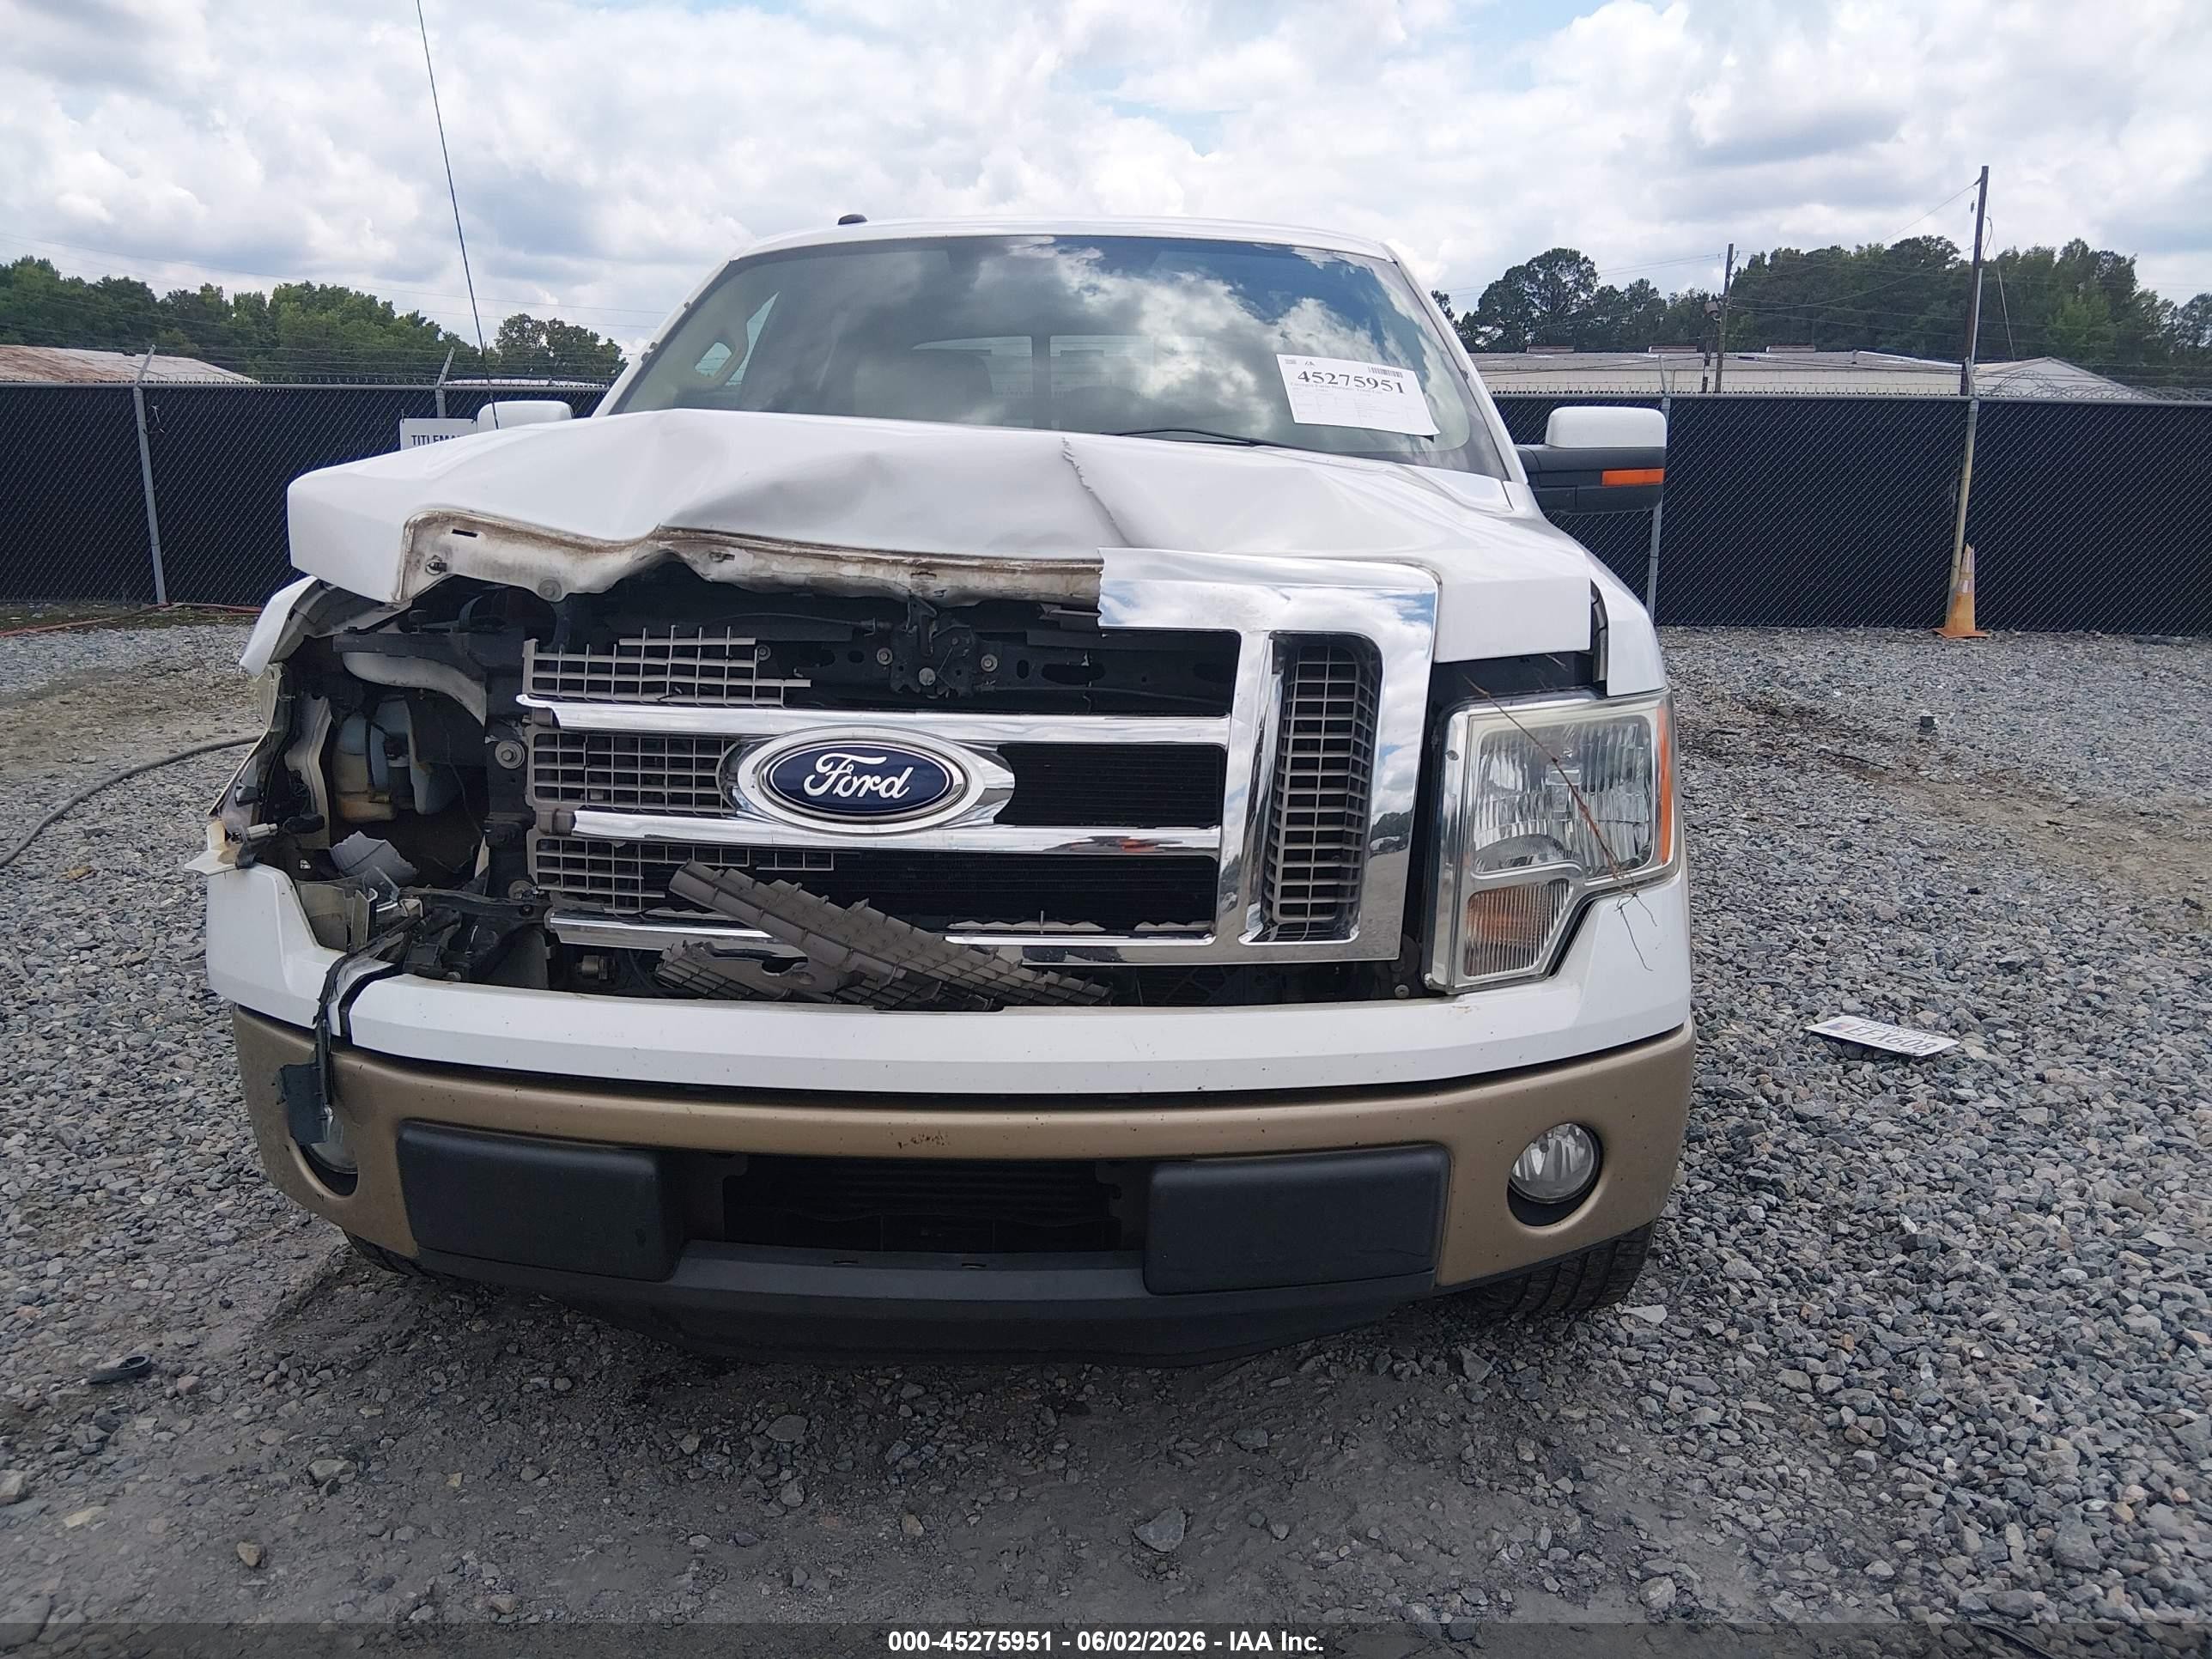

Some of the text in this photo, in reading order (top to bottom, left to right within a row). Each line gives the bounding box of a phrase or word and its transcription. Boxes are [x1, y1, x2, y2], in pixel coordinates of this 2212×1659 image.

[1297, 370, 1405, 394] 45275951
[803, 752, 915, 799] Ford
[1845, 1026, 1937, 1051] EFX608
